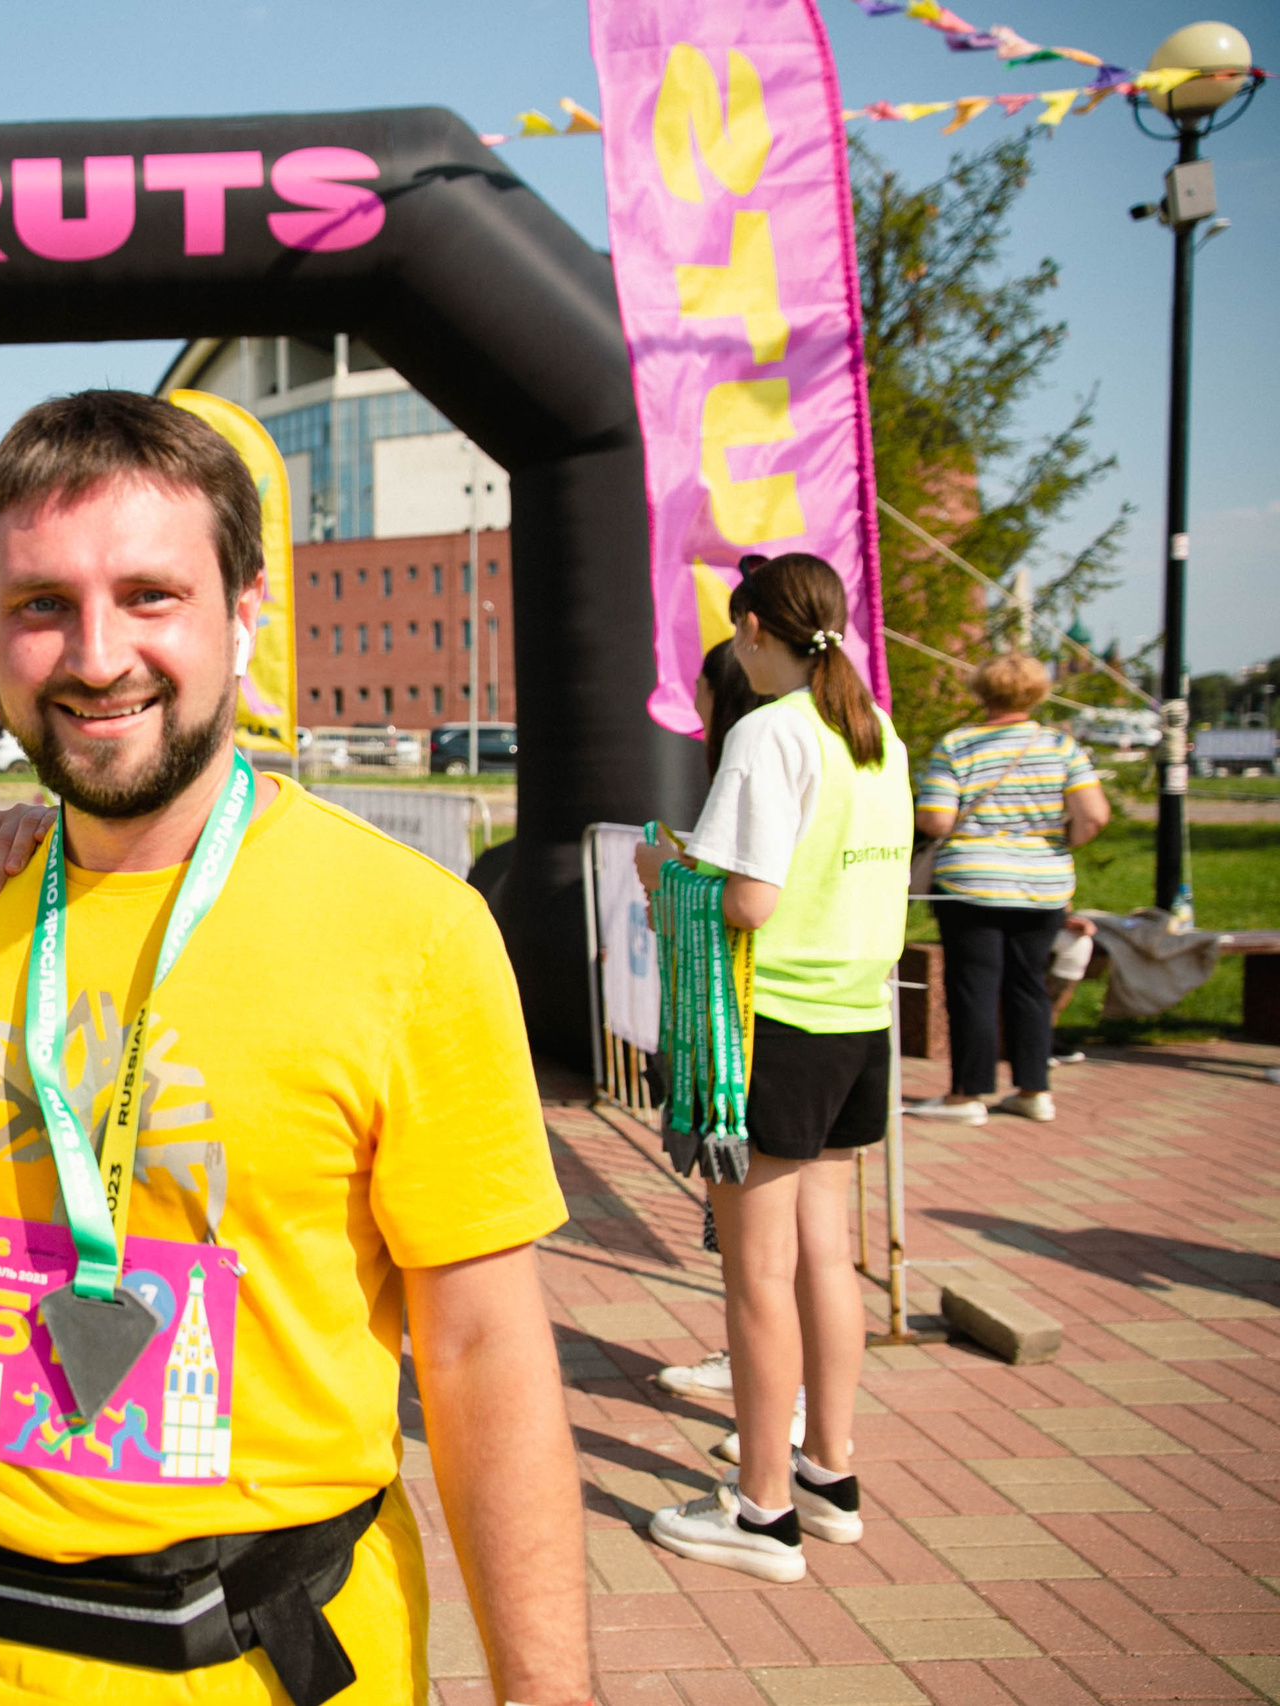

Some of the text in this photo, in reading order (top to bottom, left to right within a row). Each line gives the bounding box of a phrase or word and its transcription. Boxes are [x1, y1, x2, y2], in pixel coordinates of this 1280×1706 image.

[652, 42, 806, 655] UTS
[46, 870, 58, 905] ПО
[37, 908, 58, 1064] ЯРОСЛАВЛЮ
[118, 1008, 146, 1126] RUSSIAN
[44, 1086, 80, 1149] RUTS
[18, 1269, 48, 1286] 2023
